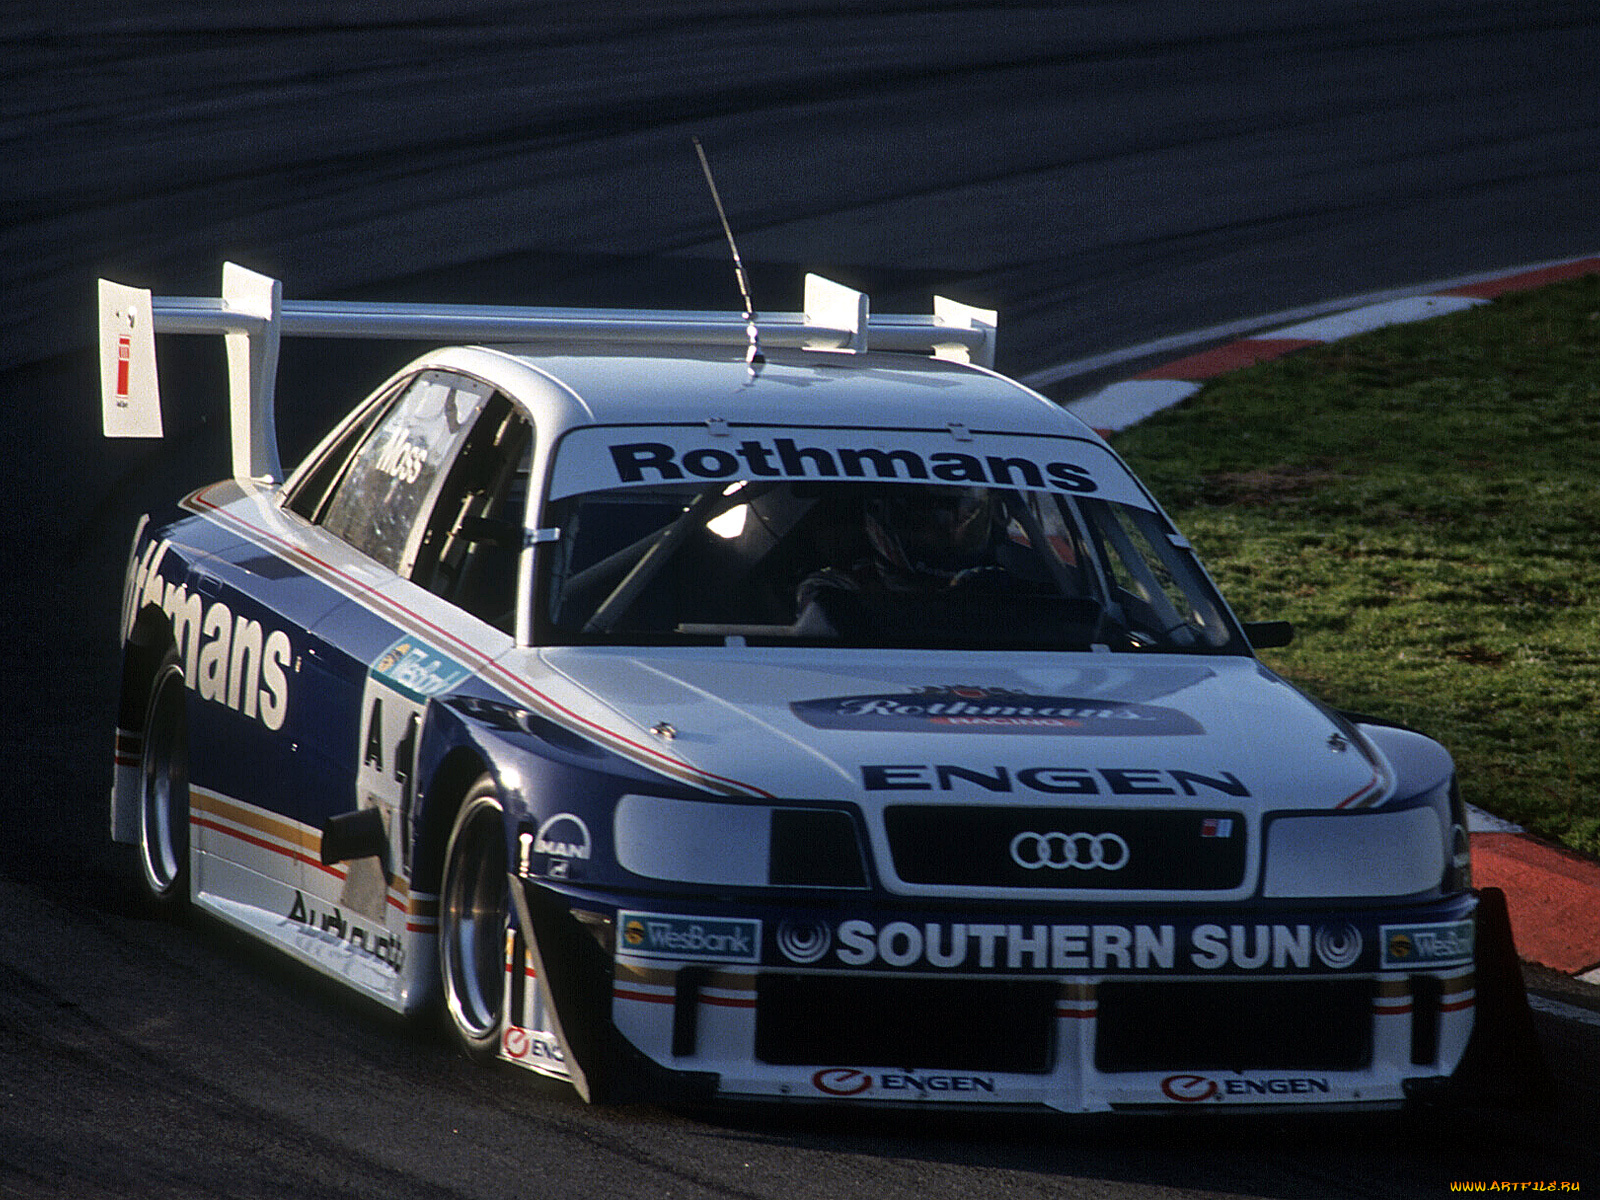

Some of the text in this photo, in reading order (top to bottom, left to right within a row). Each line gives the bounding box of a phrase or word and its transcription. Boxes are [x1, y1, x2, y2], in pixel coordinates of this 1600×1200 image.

[609, 438, 1099, 494] Rothmans
[836, 699, 1157, 721] Rothmans
[946, 717, 1065, 727] RACING
[860, 765, 1251, 798] ENGEN
[535, 839, 590, 860] MAN
[646, 921, 750, 953] WesBank
[836, 919, 1311, 969] SOUTHERN SUN
[880, 1074, 995, 1092] ENGEN
[1224, 1078, 1330, 1095] ENGEN
